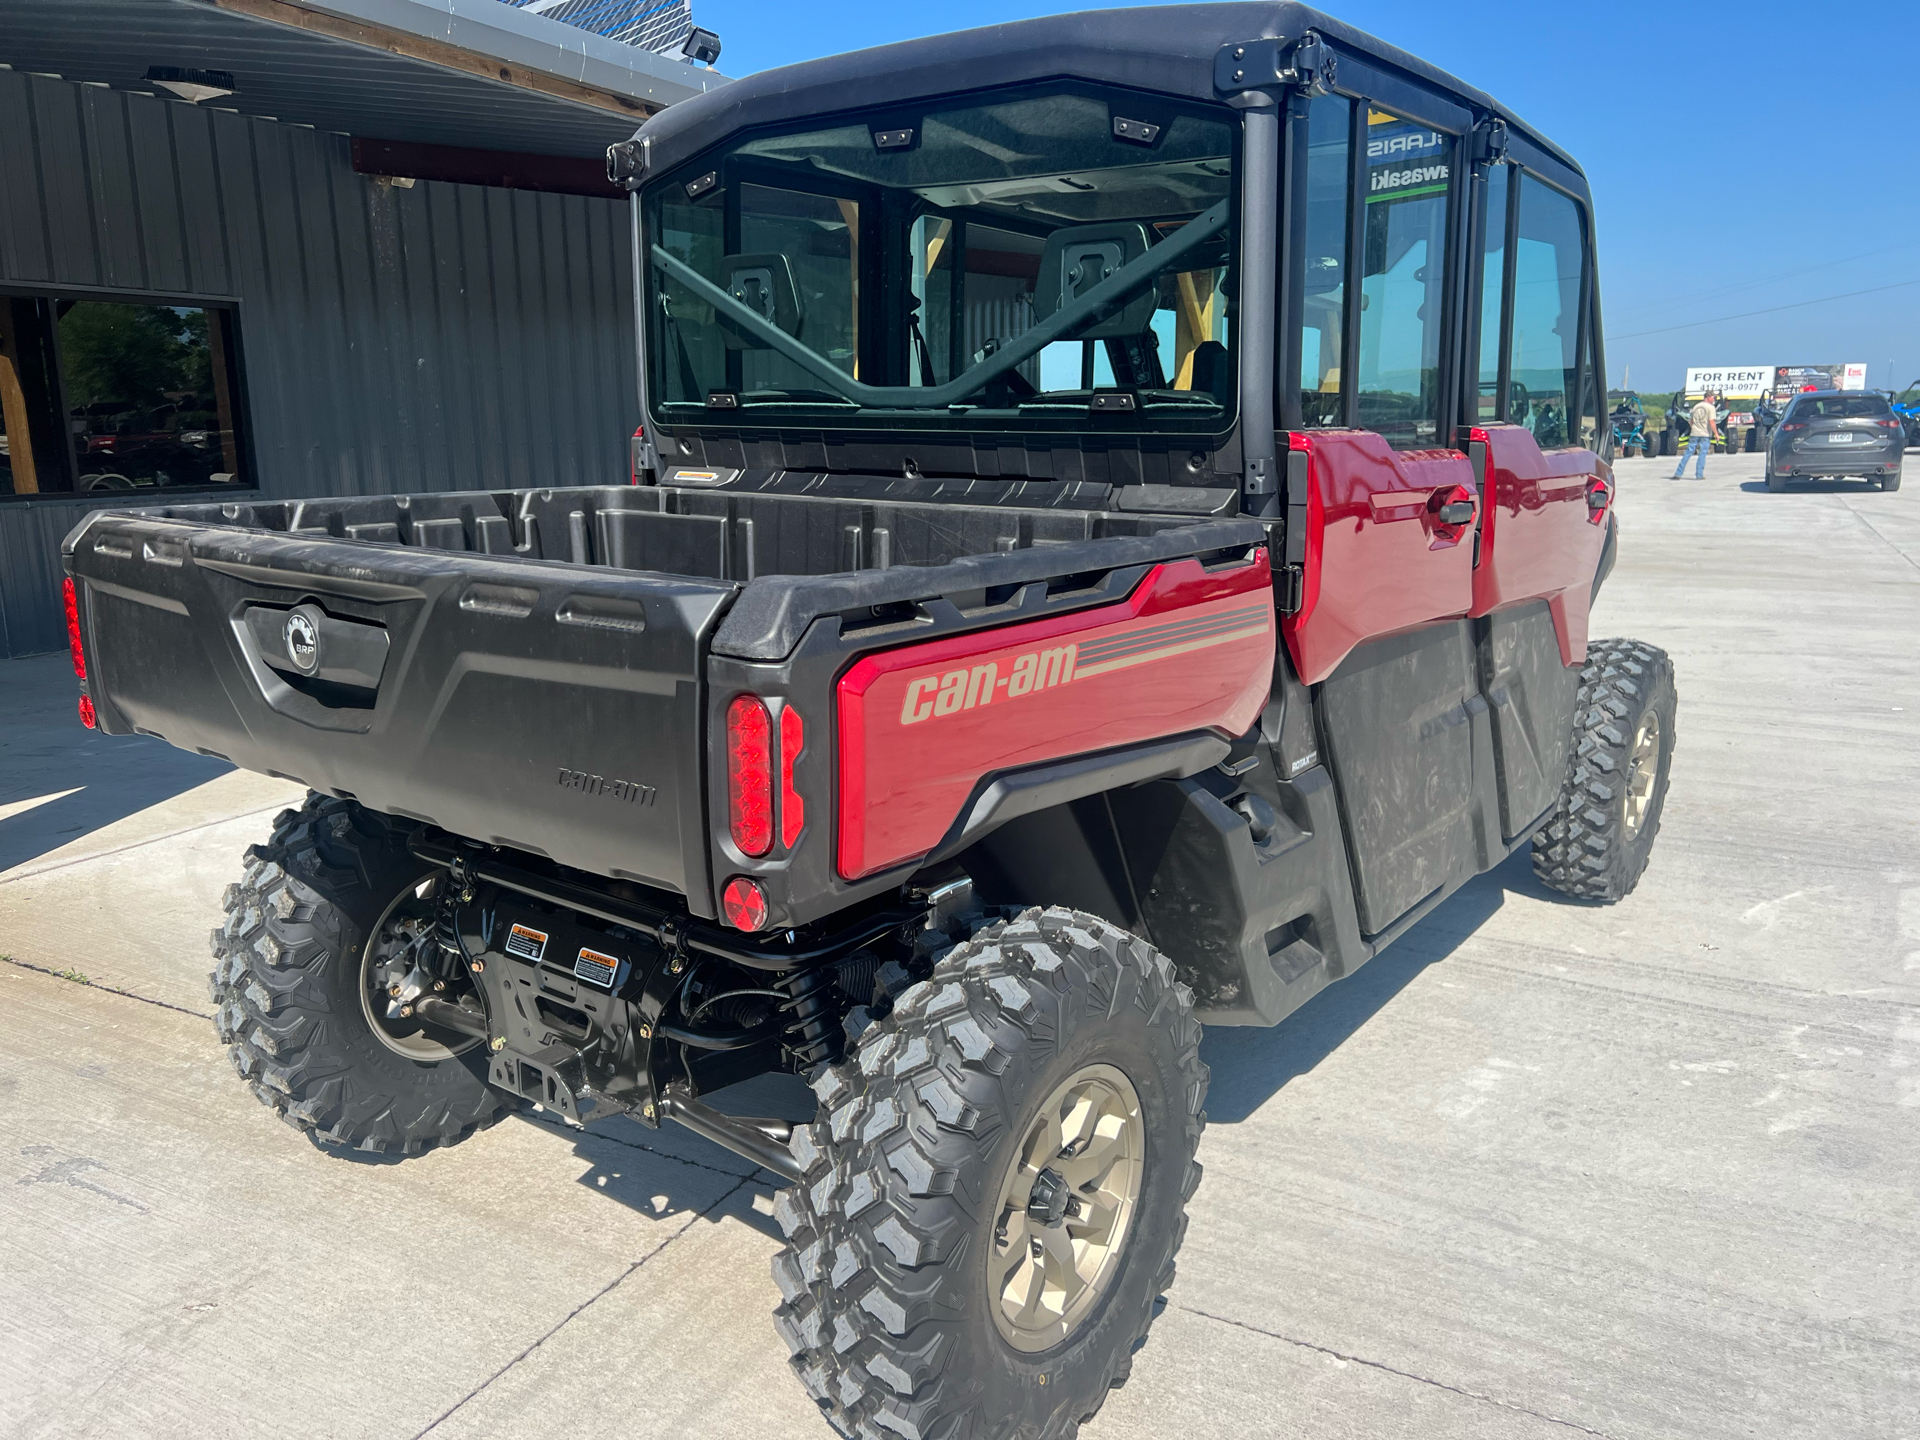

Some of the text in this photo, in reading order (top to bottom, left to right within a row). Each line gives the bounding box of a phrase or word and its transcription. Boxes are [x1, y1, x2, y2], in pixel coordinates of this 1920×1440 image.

[1694, 371, 1765, 382] FOR RENT
[1700, 383, 1759, 391] 417-234-0977
[296, 643, 315, 655] BRP
[901, 644, 1077, 725] can-am
[521, 930, 542, 940] WARNING
[590, 954, 611, 965] WARNING
